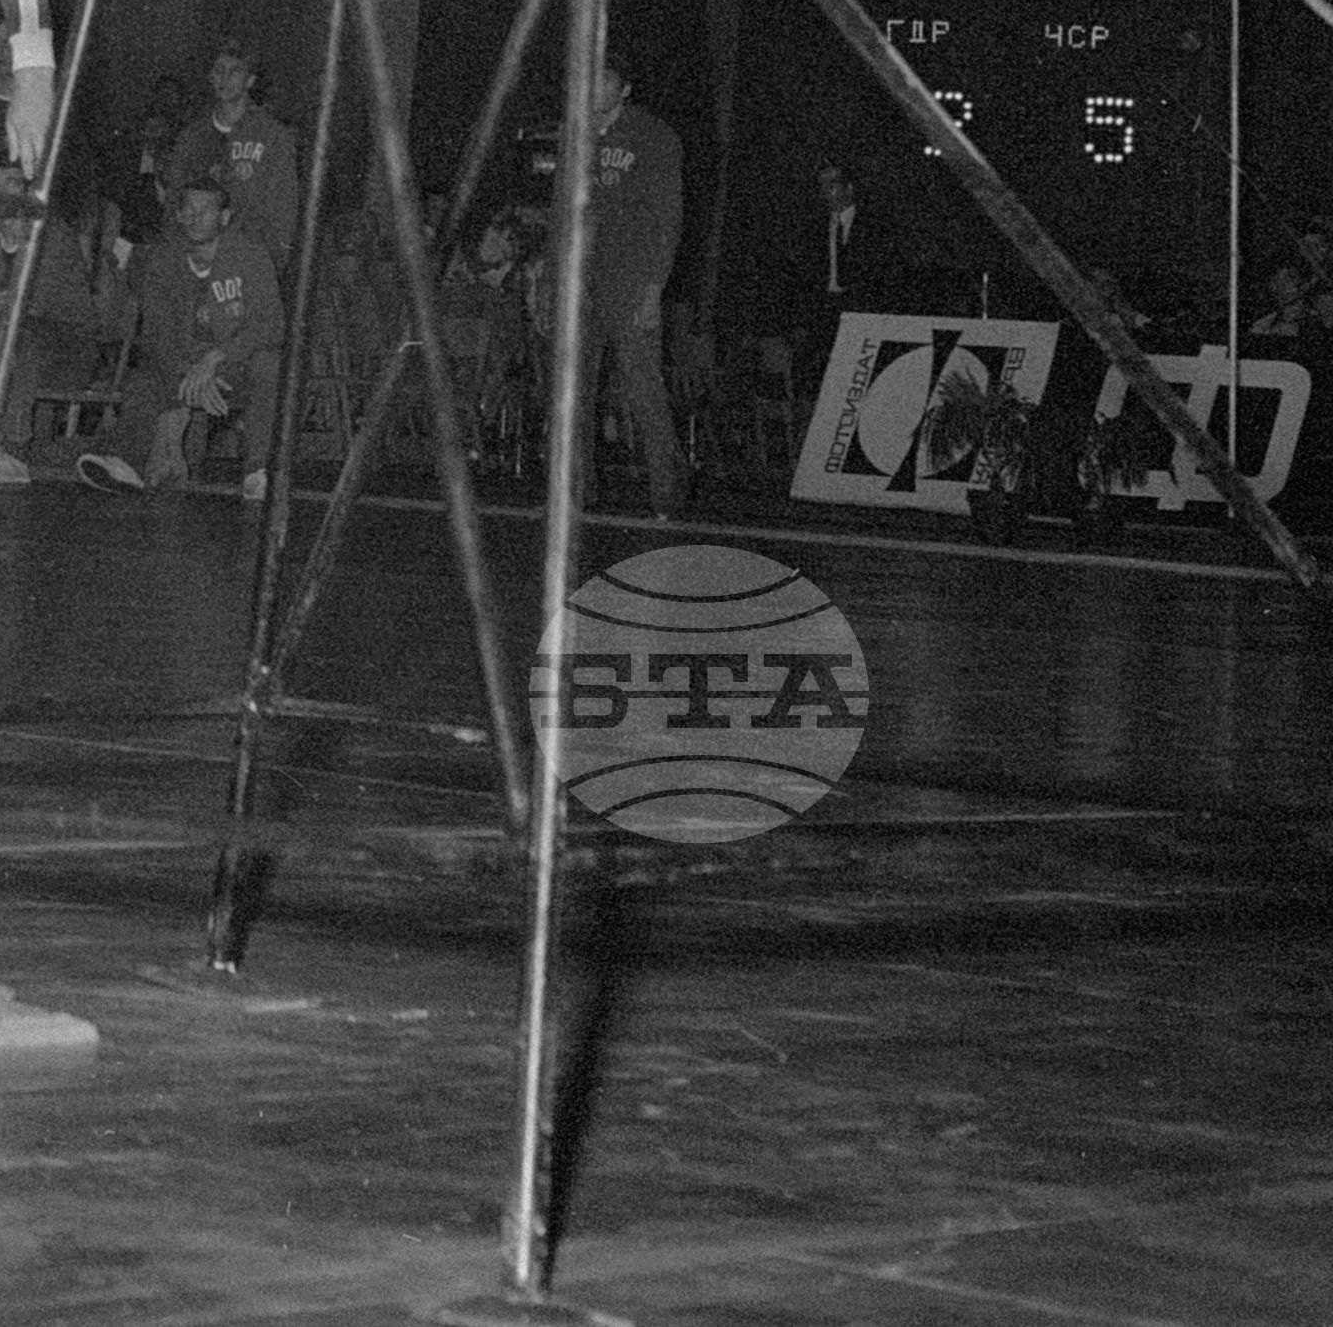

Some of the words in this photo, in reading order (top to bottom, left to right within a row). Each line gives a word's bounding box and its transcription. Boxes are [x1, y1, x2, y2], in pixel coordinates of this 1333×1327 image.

[886, 19, 950, 44] ГДР
[1044, 24, 1110, 49] ЧСР
[1085, 95, 1134, 163] 5
